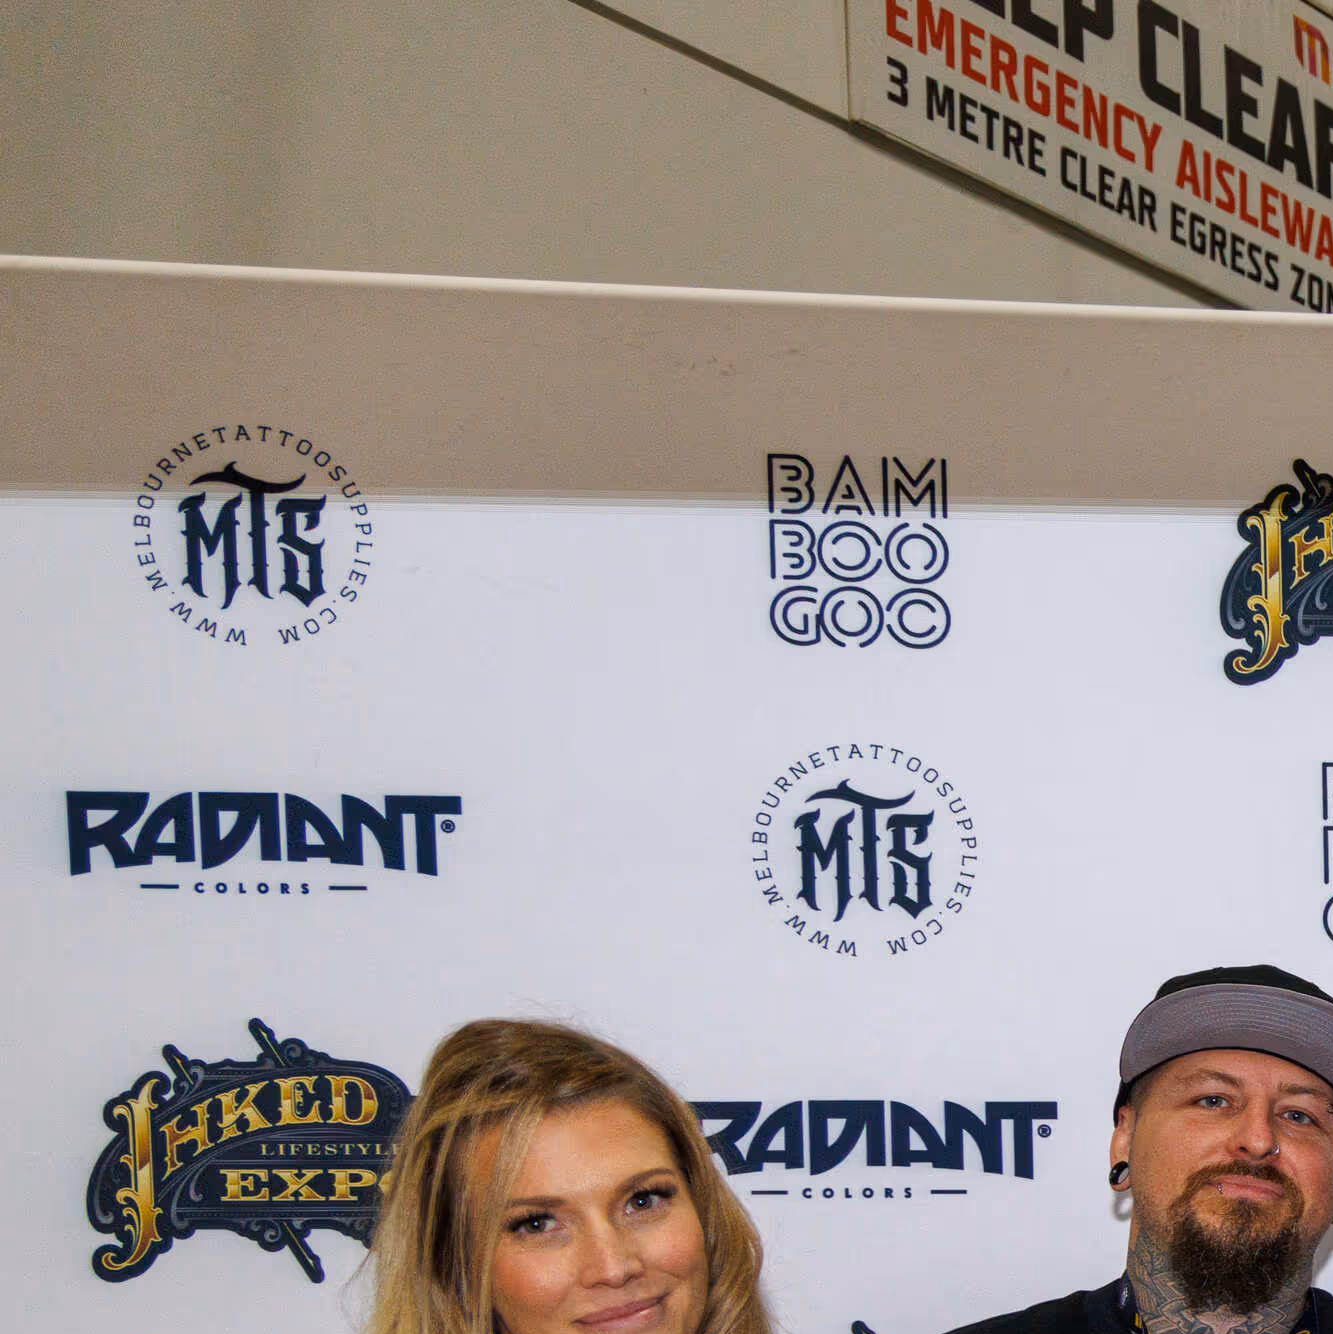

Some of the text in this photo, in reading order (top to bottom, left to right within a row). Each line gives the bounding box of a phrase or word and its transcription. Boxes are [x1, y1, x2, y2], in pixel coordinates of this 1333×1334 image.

[884, 0, 1164, 174] EMERGENCY
[886, 56, 909, 107] 3
[926, 76, 1046, 176] METRE
[1060, 147, 1157, 232] CLEAR
[1170, 201, 1279, 292] EGRESS
[768, 453, 948, 518] BAM
[178, 461, 327, 608] MTS
[770, 520, 949, 584] BOO
[794, 779, 934, 922] MTS
[195, 883, 309, 894] COLORS
[260, 1143, 398, 1156] LIFESTYL
[220, 1169, 393, 1201] EXP
[803, 1188, 911, 1198] COLORS
